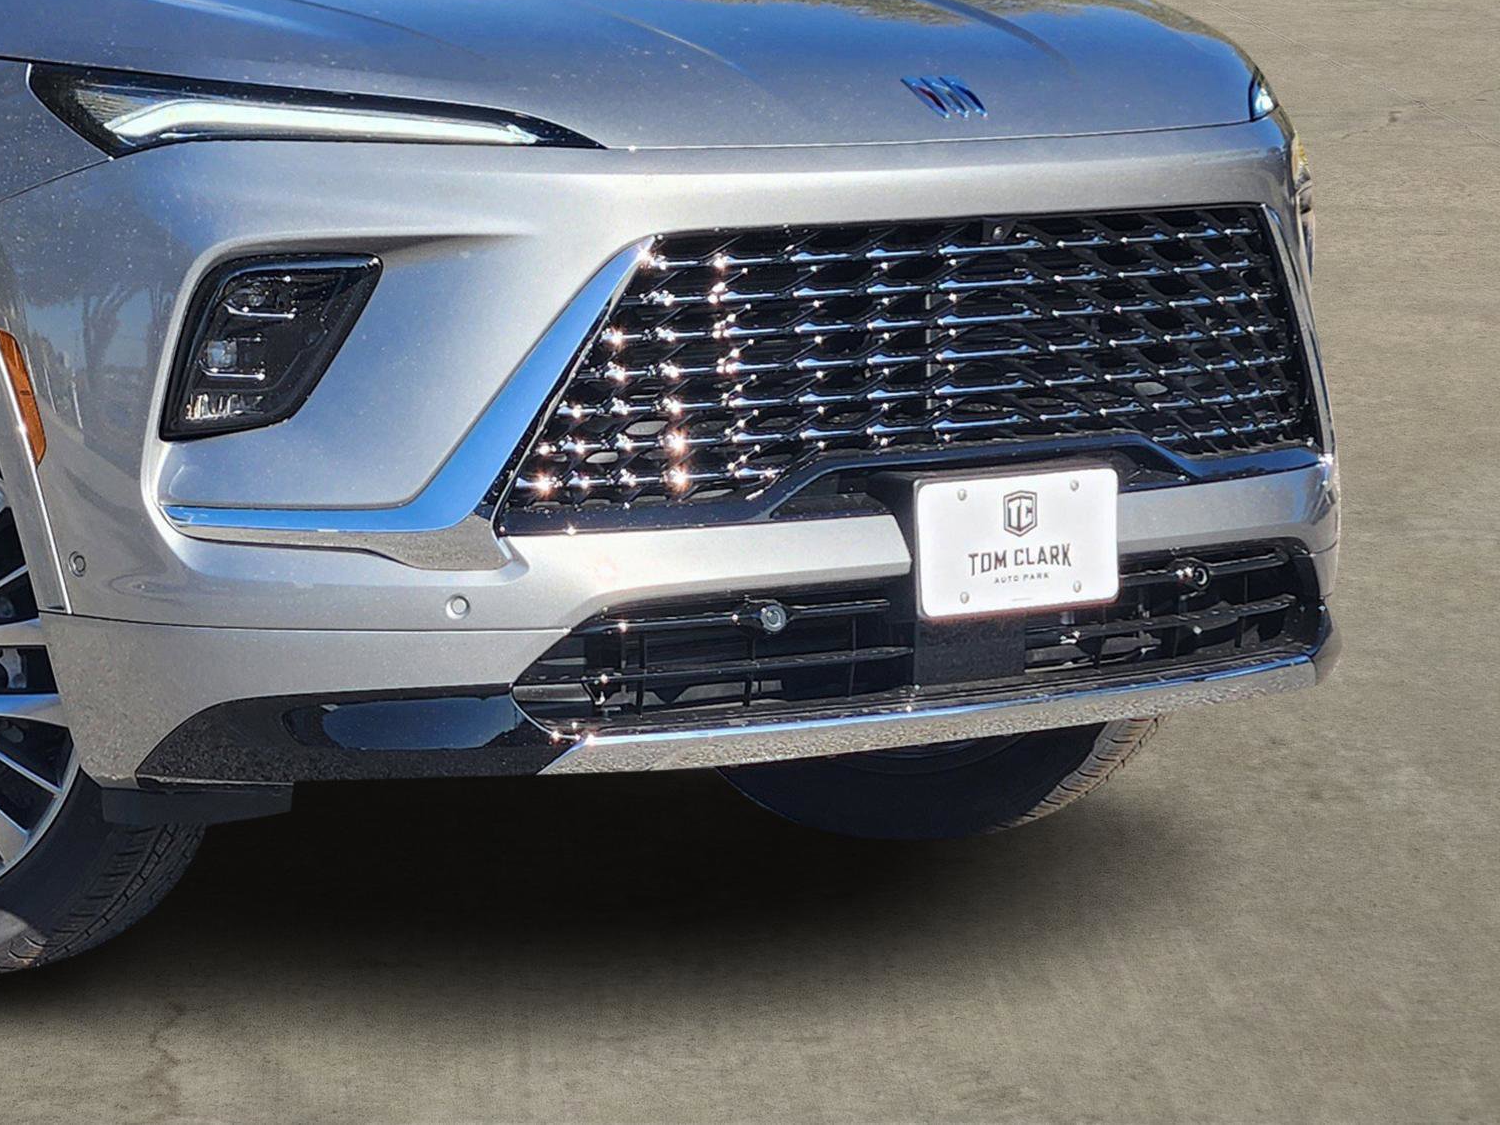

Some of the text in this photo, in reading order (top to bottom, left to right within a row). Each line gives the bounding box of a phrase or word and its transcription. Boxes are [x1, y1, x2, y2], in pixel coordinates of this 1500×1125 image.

[968, 544, 1072, 576] TOM CLARK
[994, 572, 1049, 584] AUTO PARK
